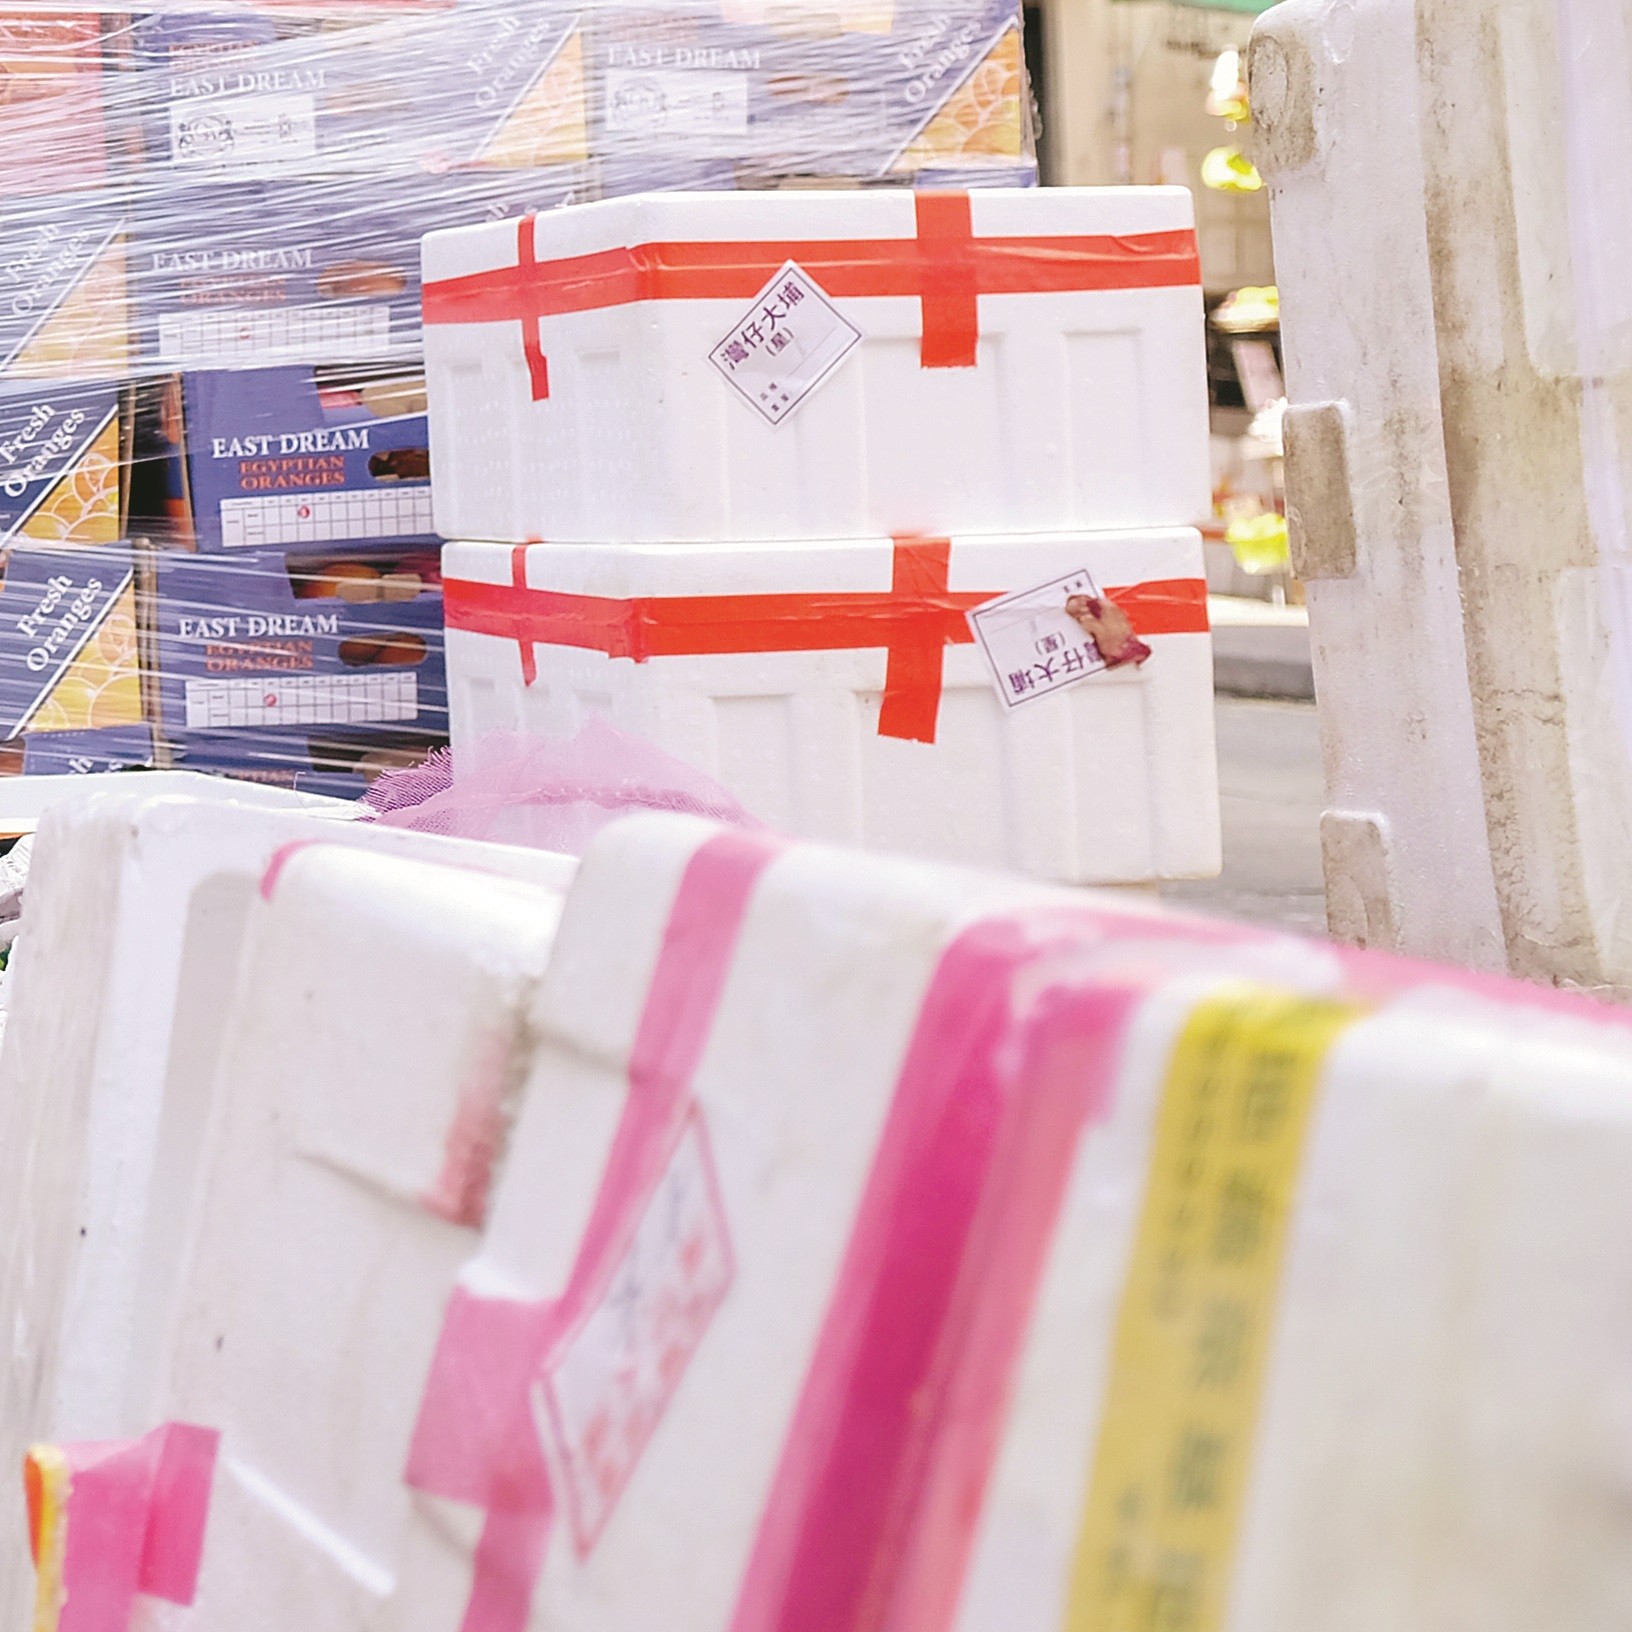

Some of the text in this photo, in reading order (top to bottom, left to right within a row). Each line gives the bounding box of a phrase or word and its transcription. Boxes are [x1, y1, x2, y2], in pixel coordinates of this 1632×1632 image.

[607, 47, 761, 70] EAST DREAM
[904, 18, 982, 104] Oranges
[169, 70, 327, 97] EAST DREAM
[151, 249, 314, 272] EAST DREAM
[3, 406, 86, 498] Oranges
[212, 429, 370, 459] EAST DREAM
[239, 455, 345, 474] EGYPTIAN
[240, 470, 345, 490] ORANGES
[16, 572, 74, 639] Fresh
[25, 576, 103, 672] Oranges
[178, 613, 339, 640] EAST DREAM
[206, 655, 314, 673] ORANGES
